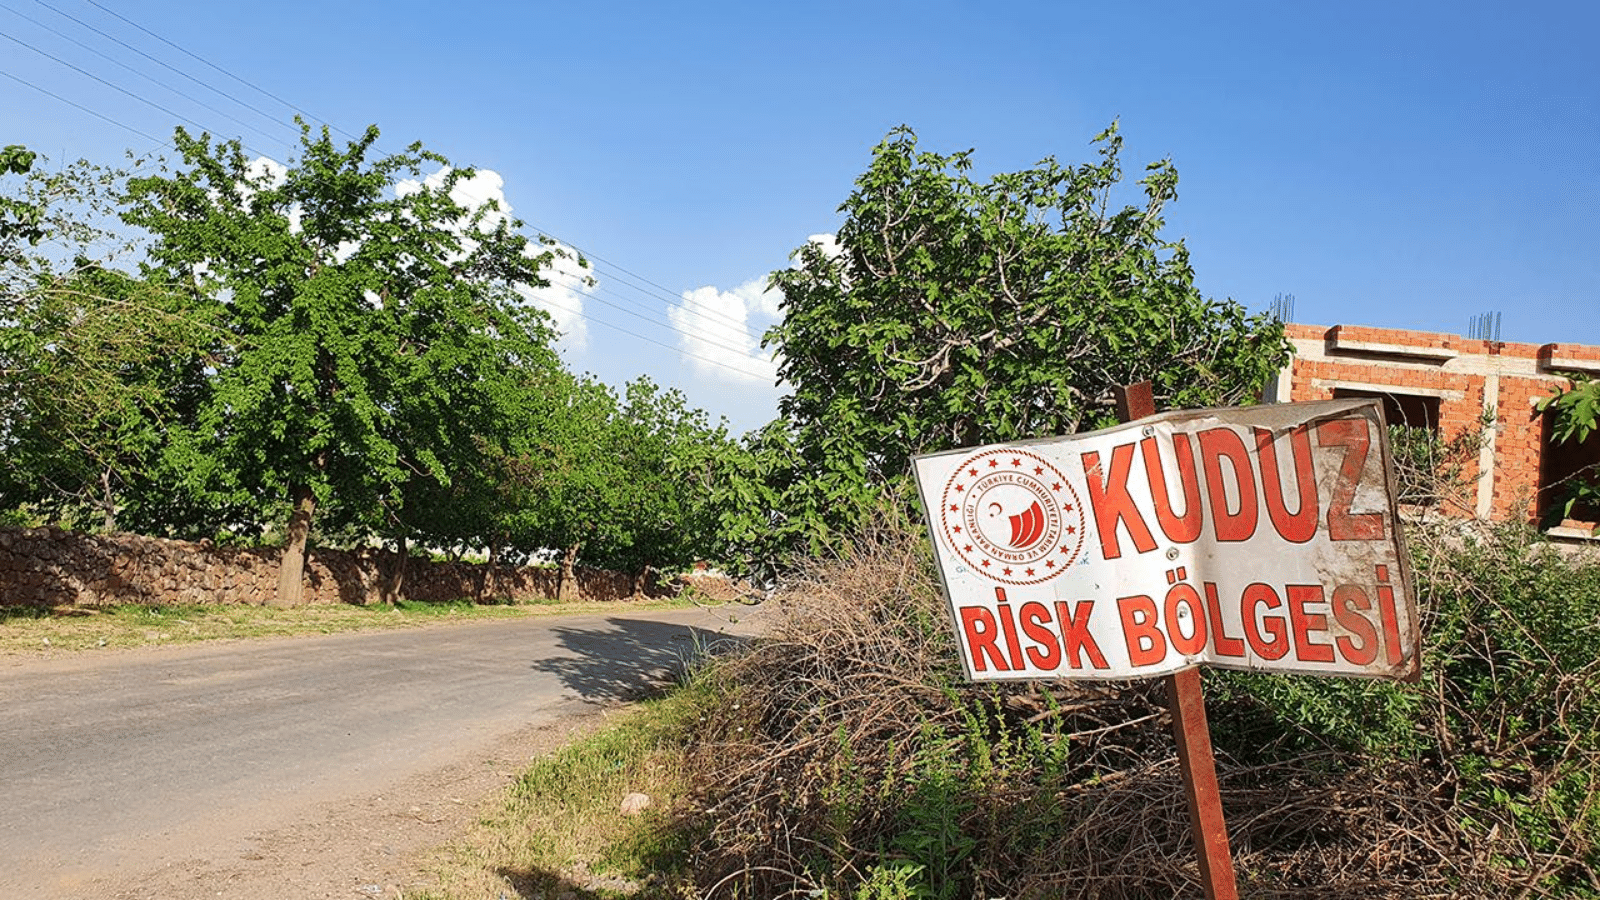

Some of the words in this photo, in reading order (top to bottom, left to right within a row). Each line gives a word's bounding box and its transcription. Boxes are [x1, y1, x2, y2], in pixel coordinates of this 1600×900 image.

[1080, 417, 1386, 560] KUDUZ
[1038, 529, 1057, 553] TARIM
[991, 547, 1025, 561] ORMAN
[1027, 550, 1039, 559] VE
[958, 586, 1109, 672] RİSK
[1116, 564, 1405, 669] BÖLGESİ
